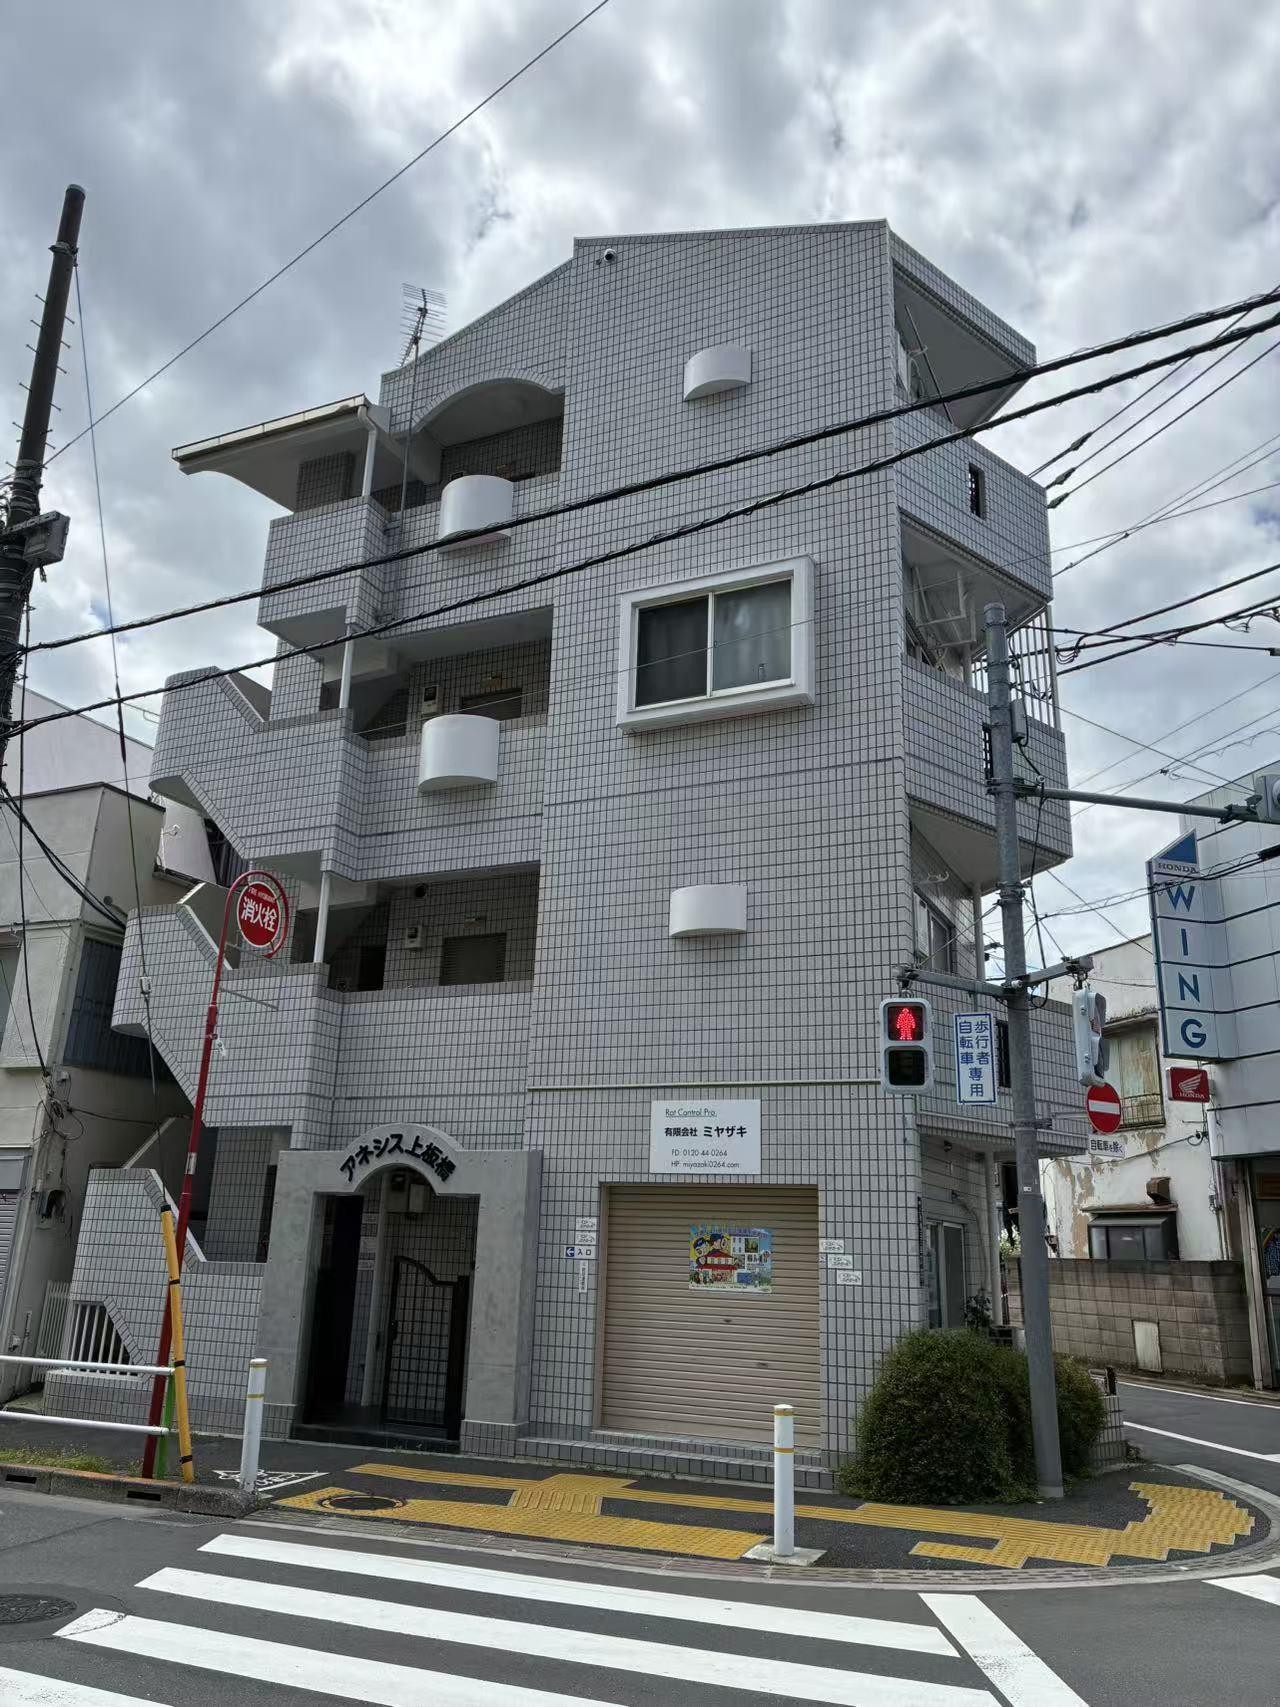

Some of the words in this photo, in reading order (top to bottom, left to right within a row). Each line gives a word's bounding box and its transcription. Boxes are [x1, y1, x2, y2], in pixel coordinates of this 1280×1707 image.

[1158, 863, 1198, 873] HONDA
[241, 896, 277, 932] 消火栓
[1167, 885, 1207, 1049] WING
[959, 1020, 974, 1065] 自転車
[974, 1020, 990, 1065] 歩行者
[969, 1067, 984, 1097] 専用
[1179, 1091, 1205, 1099] HONDA
[665, 1108, 677, 1117] Rat
[678, 1108, 702, 1117] Control
[665, 1127, 698, 1137] 有限会社
[703, 1126, 747, 1138] ミヤザキ
[1090, 1139, 1123, 1152] 自転車を除く
[340, 1133, 456, 1182] アネシス上板橋
[682, 1149, 728, 1157] 0120-44-0264
[577, 1248, 592, 1256] 入口
